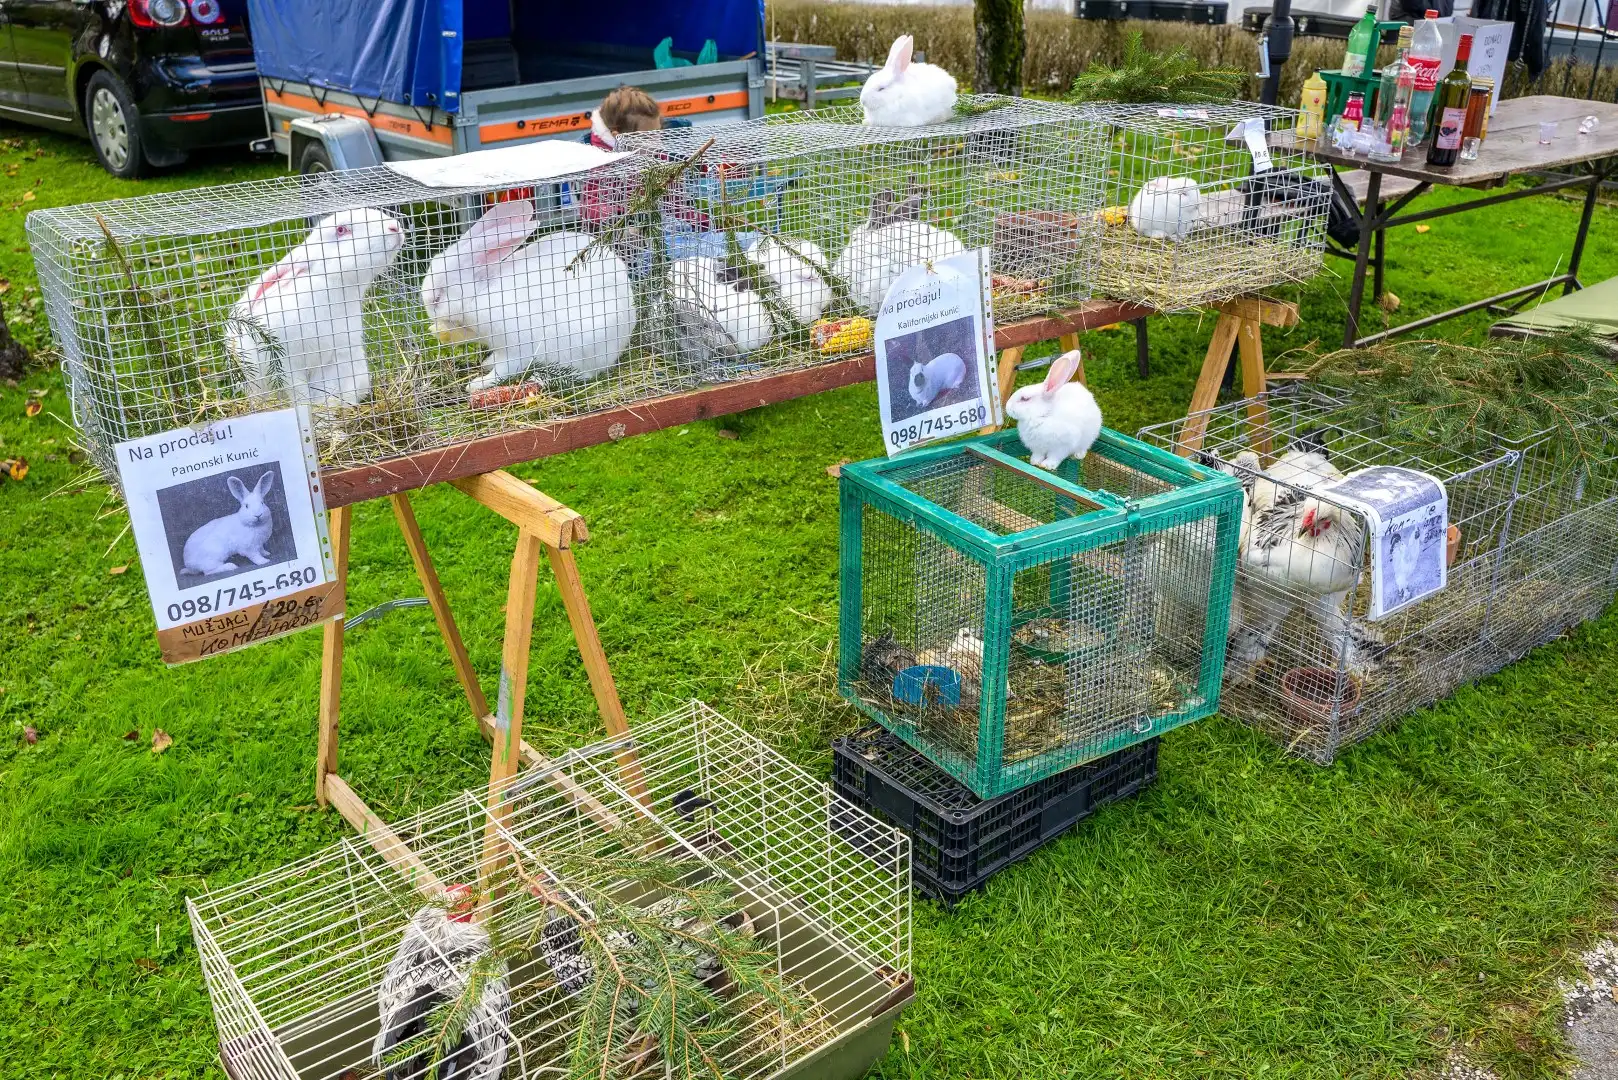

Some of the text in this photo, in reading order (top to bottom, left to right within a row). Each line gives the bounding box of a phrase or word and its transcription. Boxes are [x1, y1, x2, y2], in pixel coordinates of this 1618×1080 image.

[201, 28, 230, 38] GOLF
[667, 102, 692, 112] ECO
[531, 118, 569, 131] TEMA
[896, 288, 941, 313] prodaju!
[897, 314, 939, 330] Kalifornijski
[890, 405, 986, 446] 098/745-680
[128, 425, 233, 462] Na prodaju!
[171, 448, 259, 476] Panonski Kunić
[167, 566, 316, 621] 098/745-680
